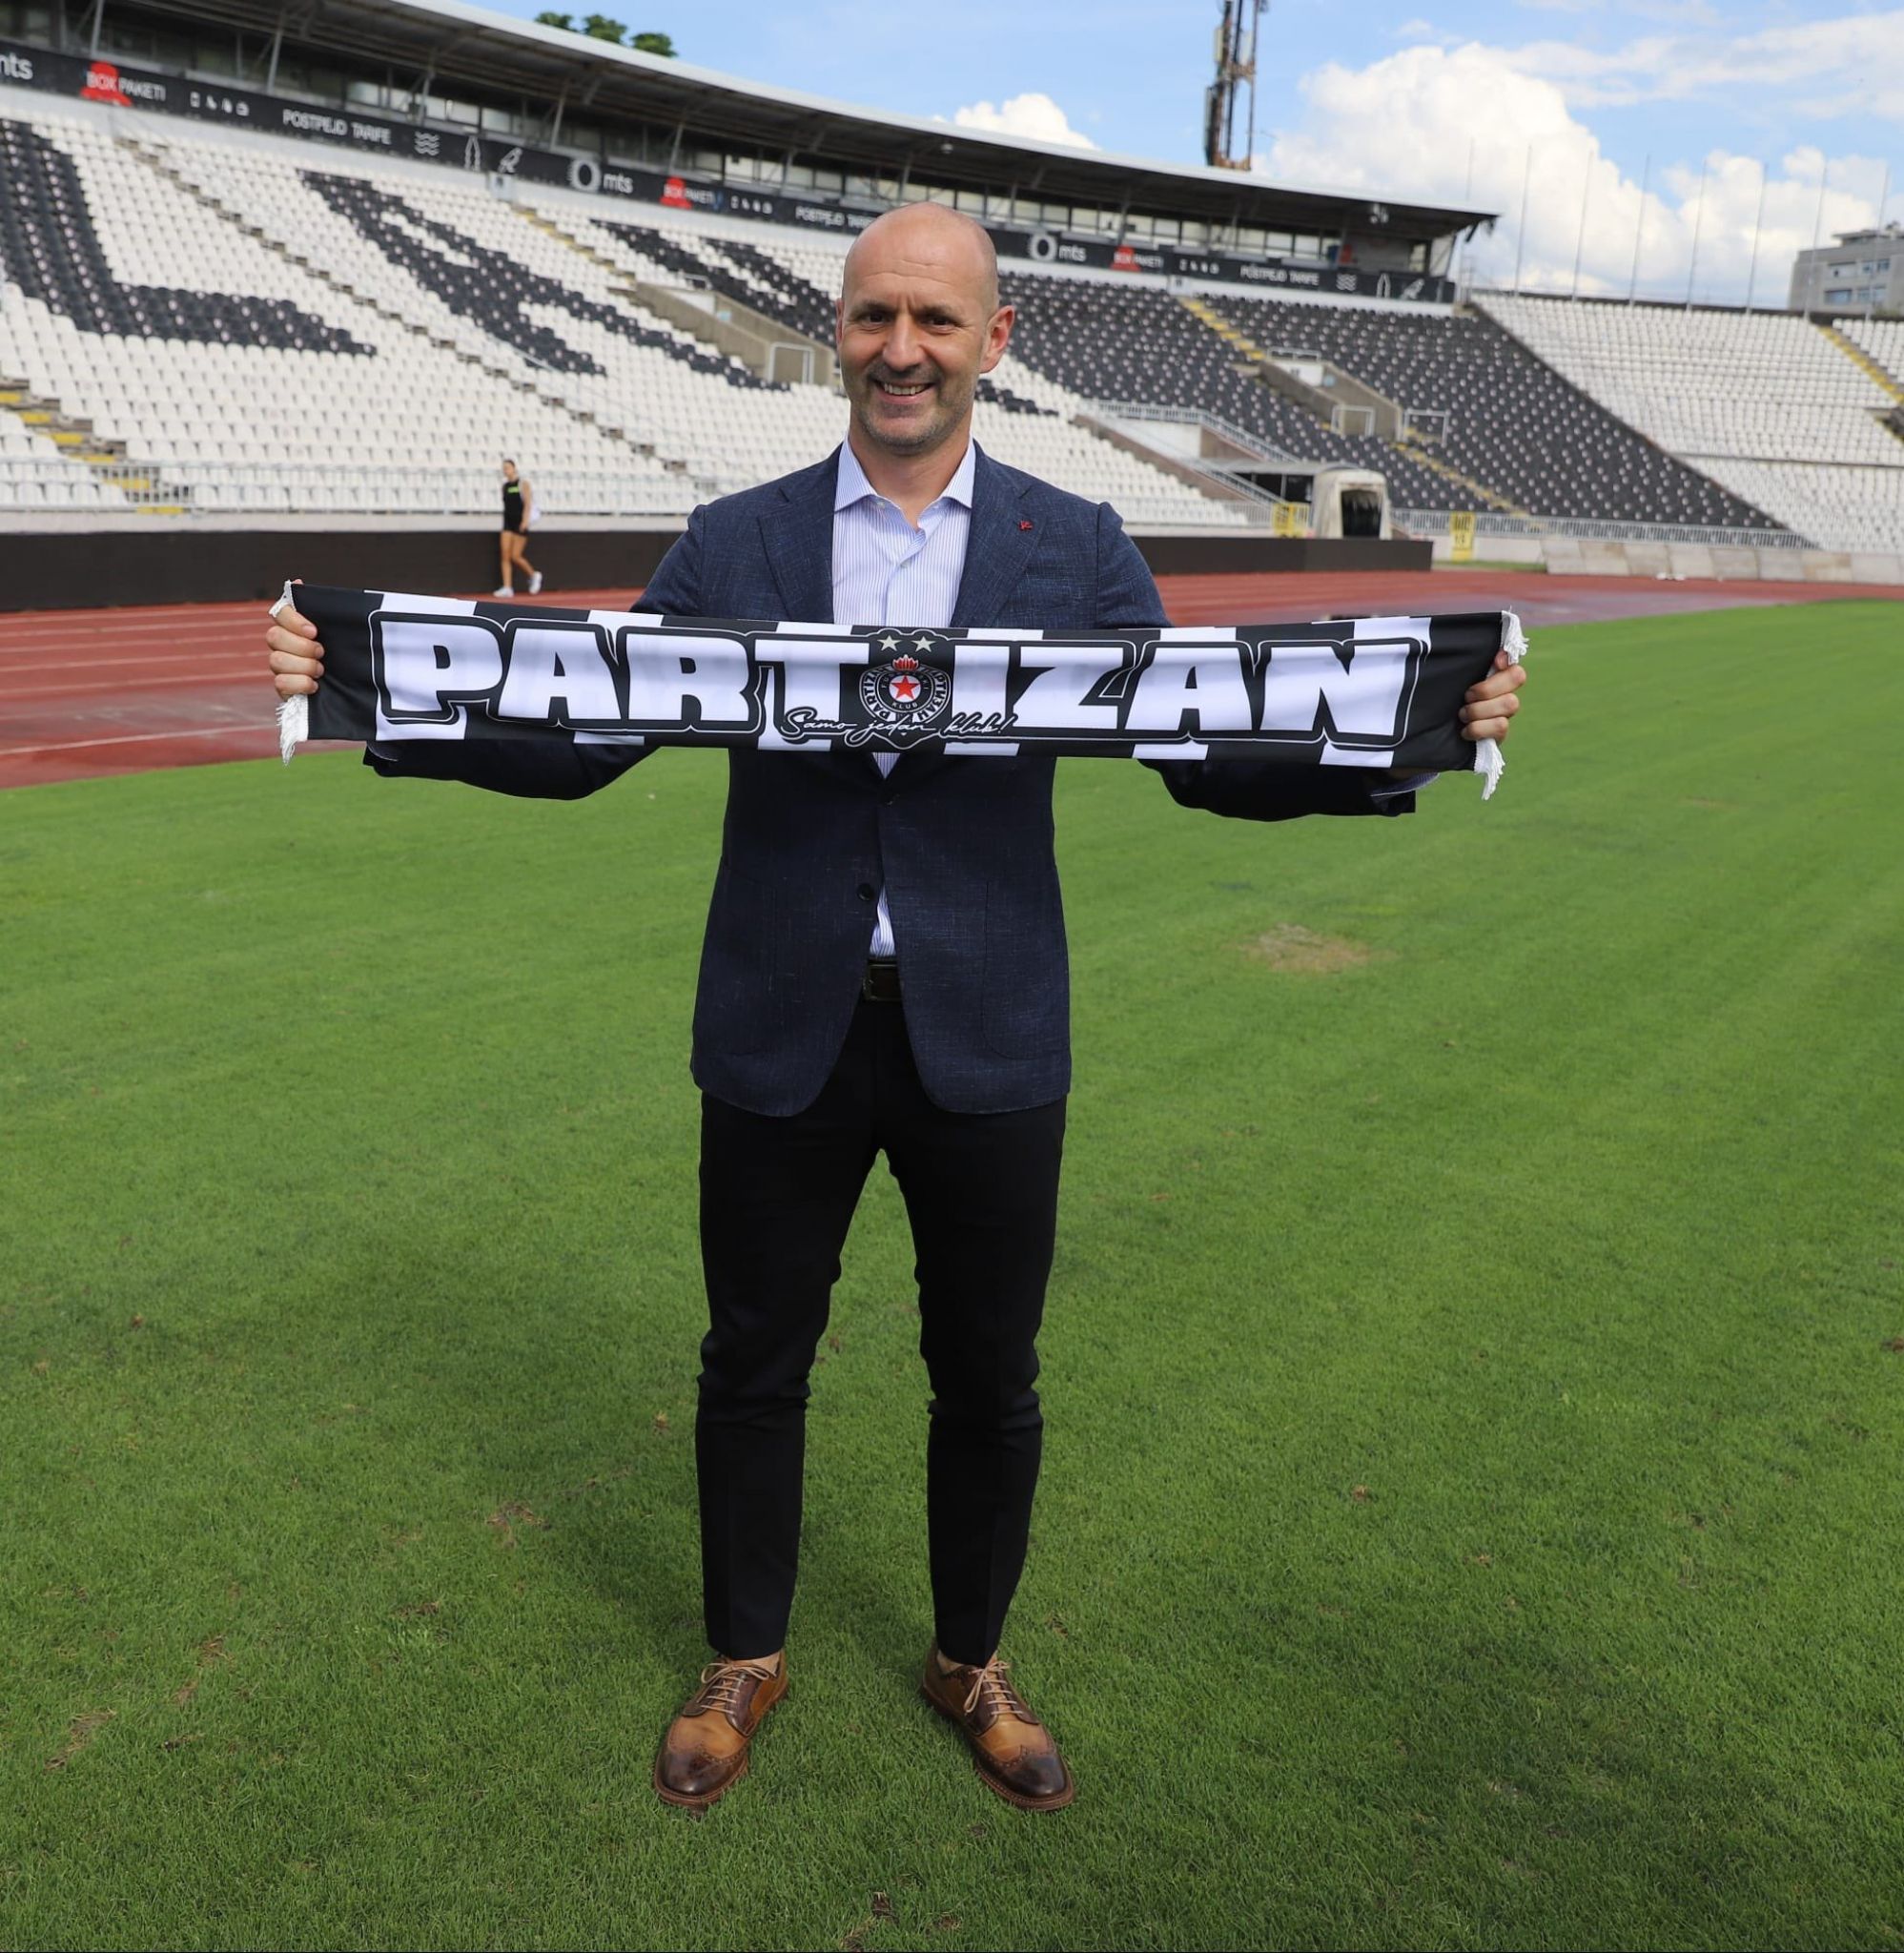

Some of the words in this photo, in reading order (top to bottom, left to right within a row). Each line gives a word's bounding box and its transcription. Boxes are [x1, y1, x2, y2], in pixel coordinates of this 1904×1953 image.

[87, 72, 118, 93] BOX
[118, 77, 166, 102] PAKETI
[603, 173, 633, 194] mts
[664, 183, 685, 198] BOX
[1059, 244, 1087, 262] mts
[891, 701, 918, 709] KLUB
[780, 709, 858, 735] Samo
[850, 713, 936, 743] jedan
